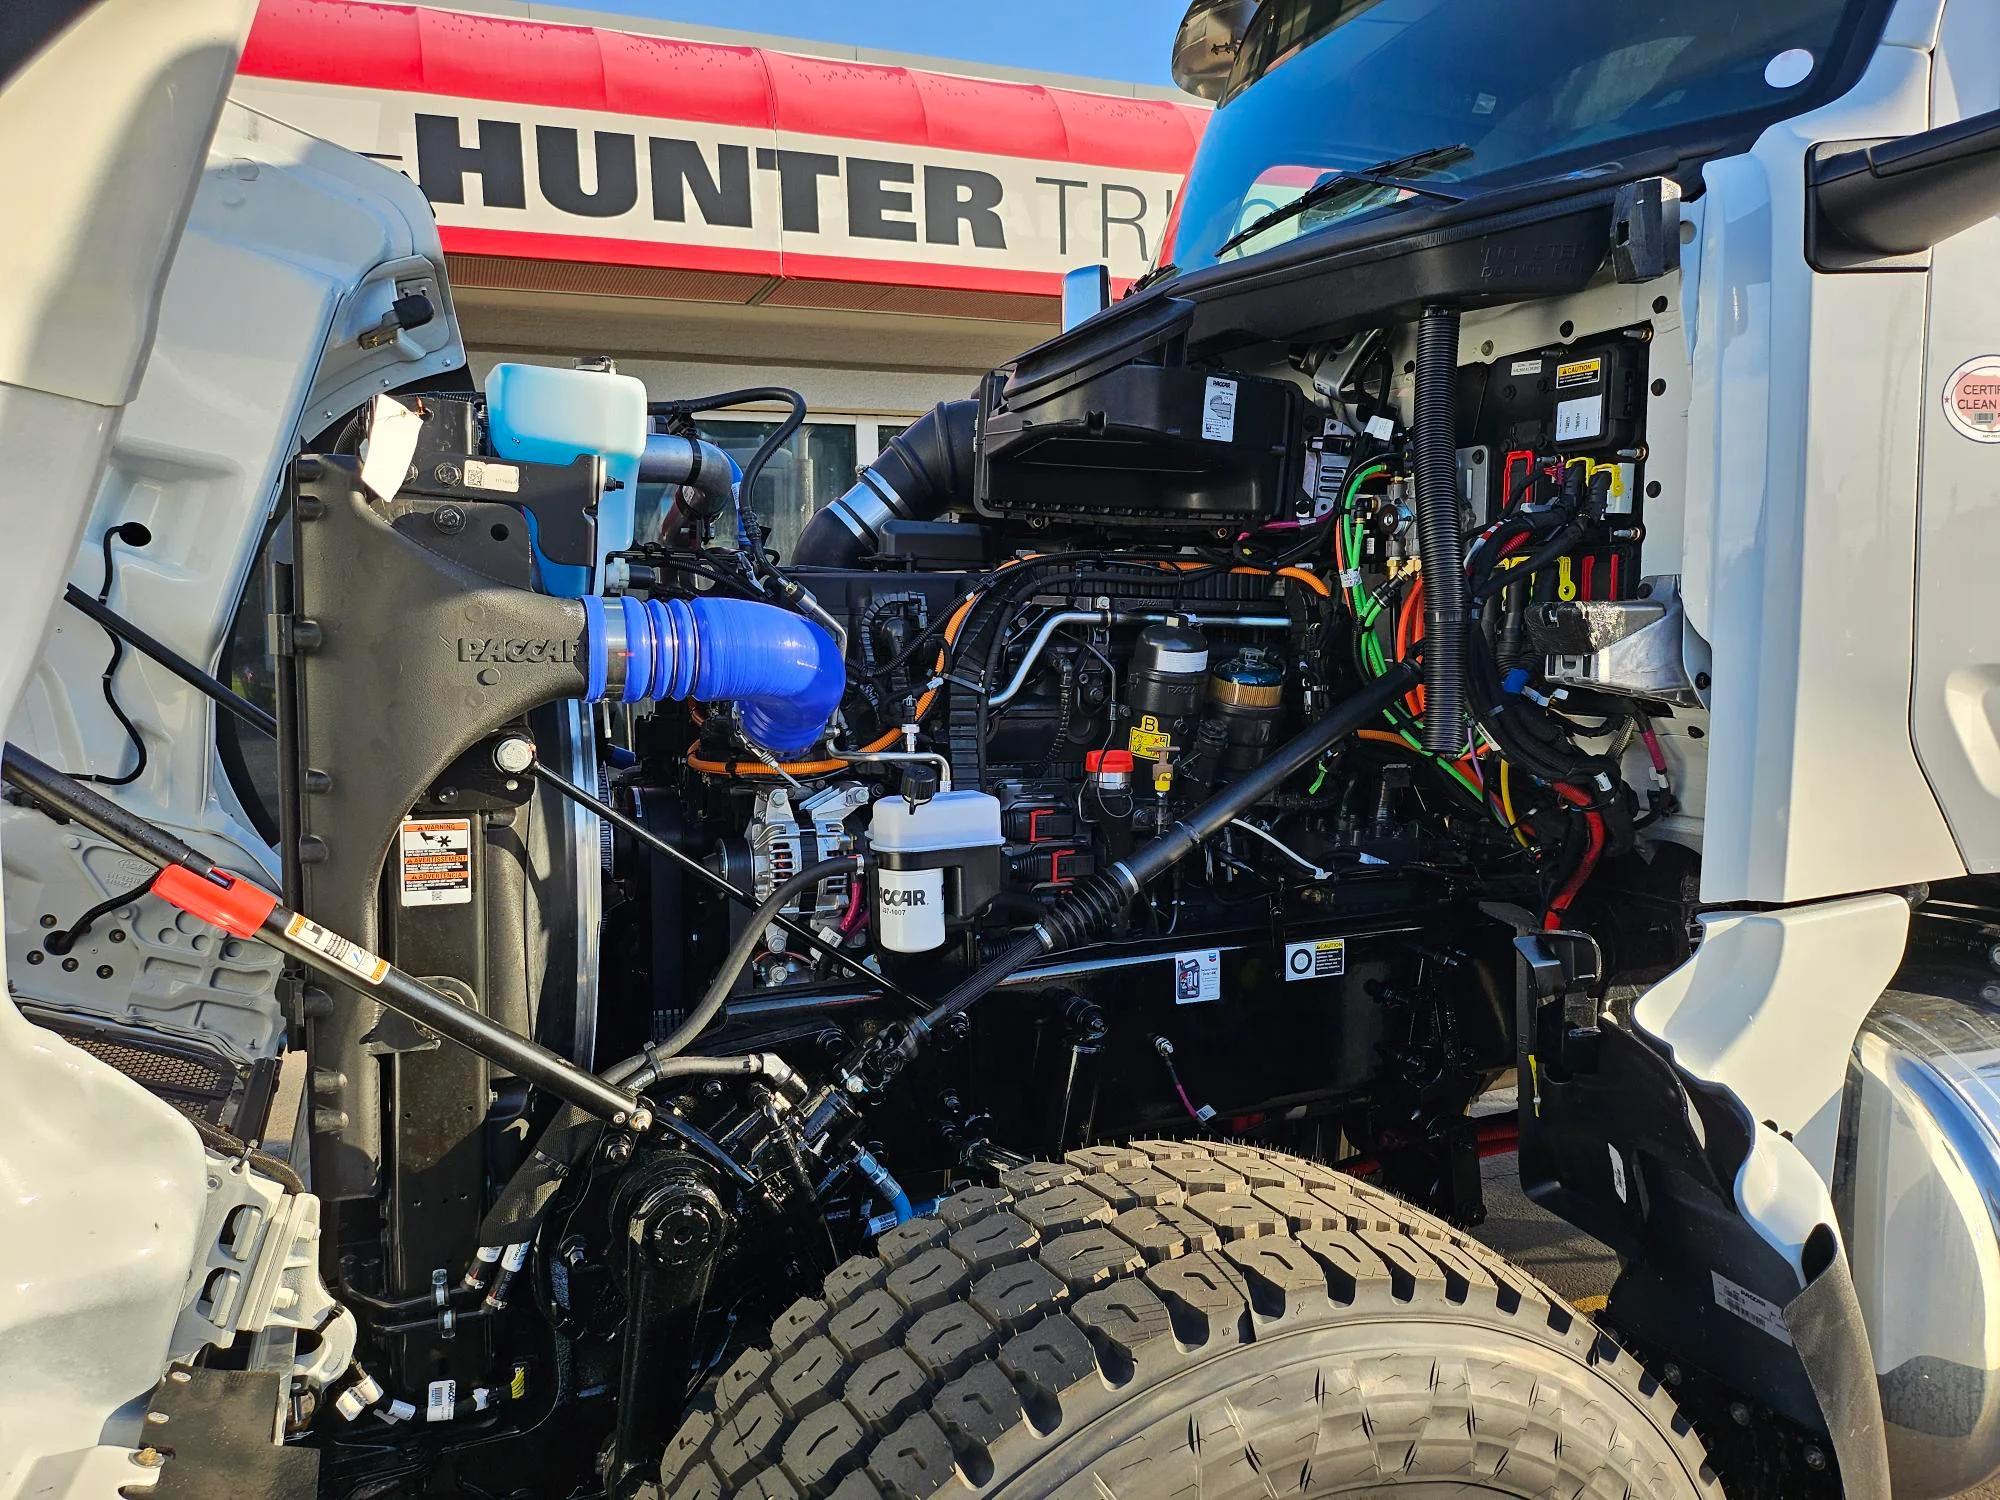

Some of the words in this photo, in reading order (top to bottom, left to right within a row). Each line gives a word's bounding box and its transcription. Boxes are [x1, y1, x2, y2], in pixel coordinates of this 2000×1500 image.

[415, 113, 1007, 250] HUNTER
[1567, 363, 1592, 374] CAUTION
[1957, 399, 1997, 410] CLEAN
[1145, 717, 1155, 732] B
[414, 855, 466, 863] AVERTISSEMENT
